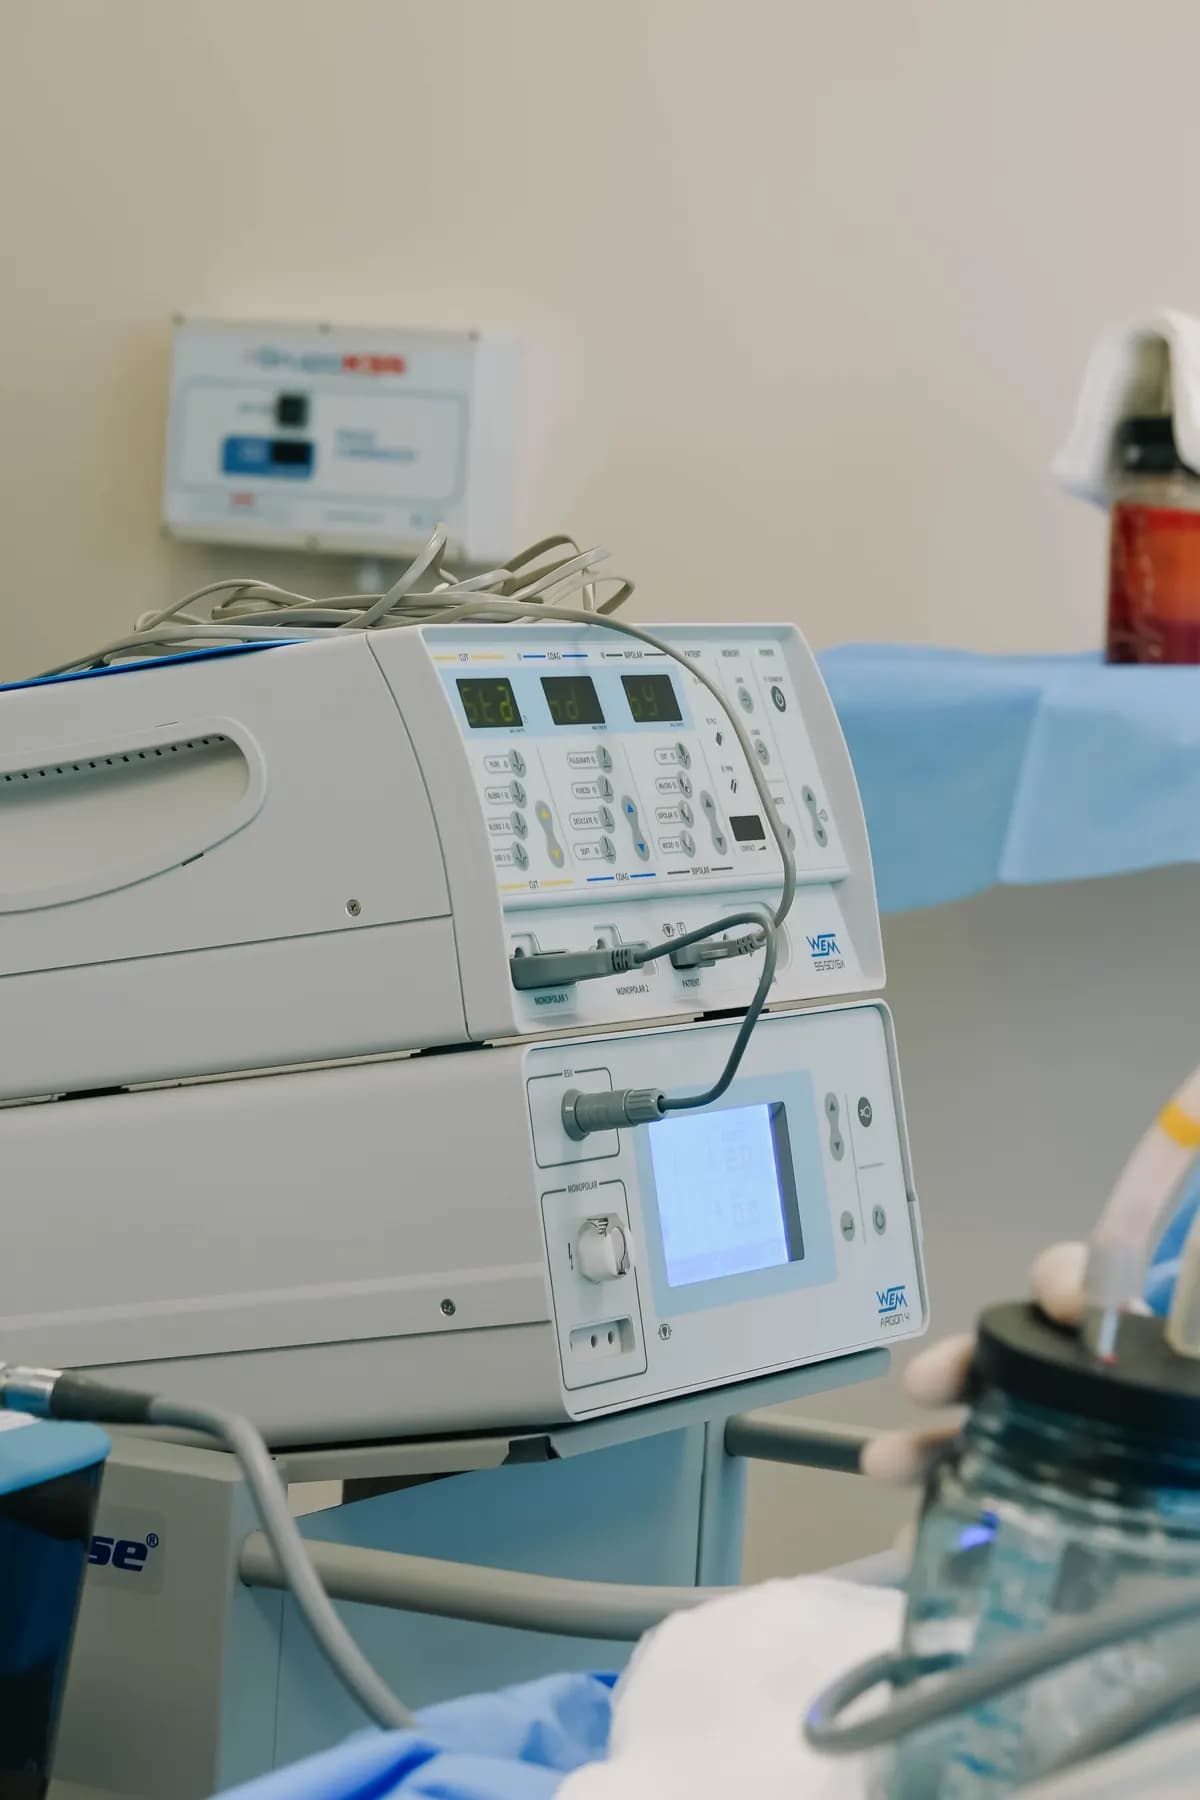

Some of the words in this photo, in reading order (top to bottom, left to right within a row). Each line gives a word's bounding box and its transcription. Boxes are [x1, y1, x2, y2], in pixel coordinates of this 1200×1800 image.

[624, 651, 642, 660] BIPOLAR
[691, 866, 710, 875] BIPOLAR
[615, 871, 630, 881] COAG
[528, 880, 539, 889] CUT
[806, 933, 841, 957] WEM
[682, 978, 700, 988] PATIENT
[616, 985, 644, 995] MONOPOLAR
[534, 995, 563, 1006] MONOPOLAR
[567, 1180, 598, 1193] MONOPOLAR
[875, 1285, 908, 1313] WEM
